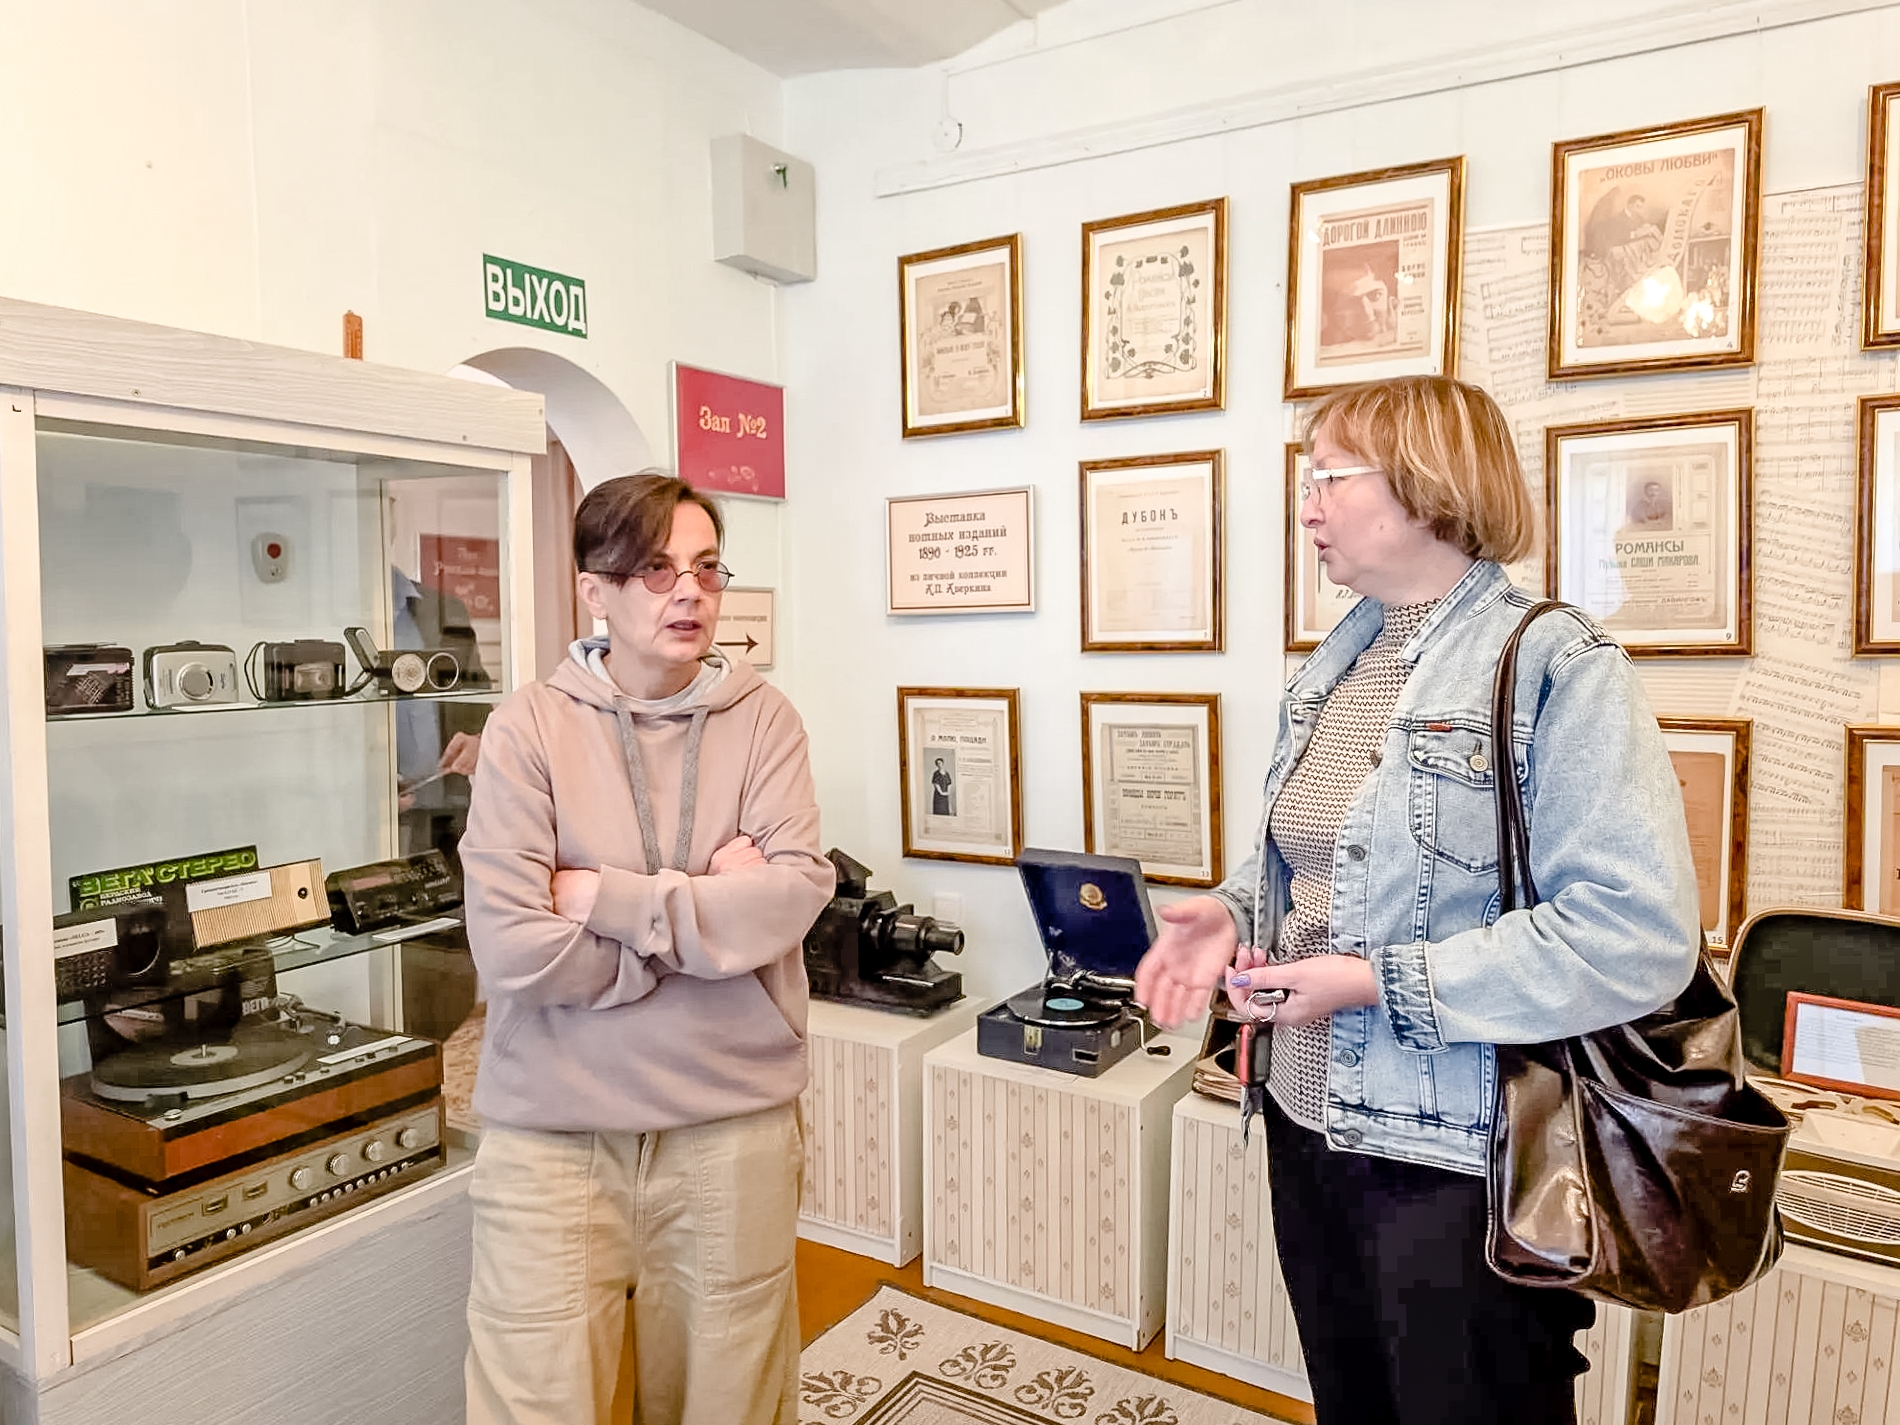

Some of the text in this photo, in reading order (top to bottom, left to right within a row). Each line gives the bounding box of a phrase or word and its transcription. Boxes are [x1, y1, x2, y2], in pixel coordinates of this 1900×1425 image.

[486, 263, 586, 334] ВЫХОД
[699, 406, 767, 439] Зал №2
[923, 512, 986, 528] Выставка
[1121, 508, 1178, 525] ДУБОНЪ
[908, 525, 1007, 543] нотных изданий
[954, 544, 978, 558] 1925
[1615, 540, 1684, 555] РОМАНСЫ
[923, 570, 955, 581] личной
[958, 570, 1007, 580] коллекции
[1725, 632, 1732, 641] 9
[156, 852, 256, 884] СТЕРЕО
[1712, 936, 1723, 944] 15
